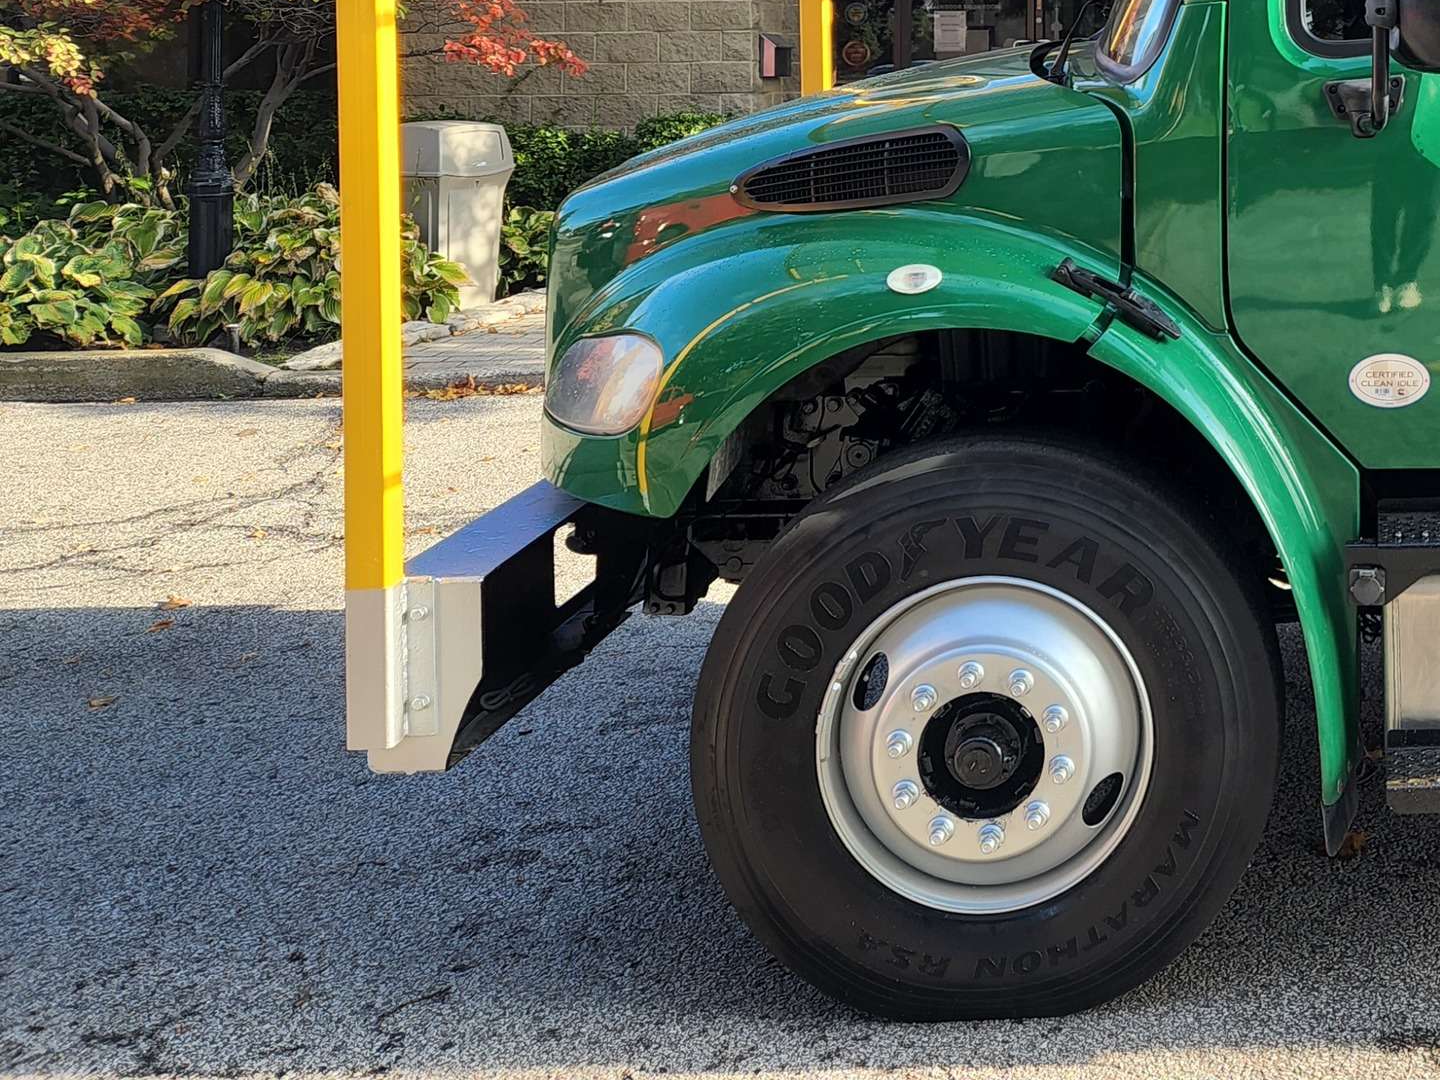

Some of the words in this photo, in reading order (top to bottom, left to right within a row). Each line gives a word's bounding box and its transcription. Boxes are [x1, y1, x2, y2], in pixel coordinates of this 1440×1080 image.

[1365, 370, 1414, 378] CERTIFIED
[1360, 379, 1393, 387] CLEAN
[756, 513, 1155, 722] GOODYEAR
